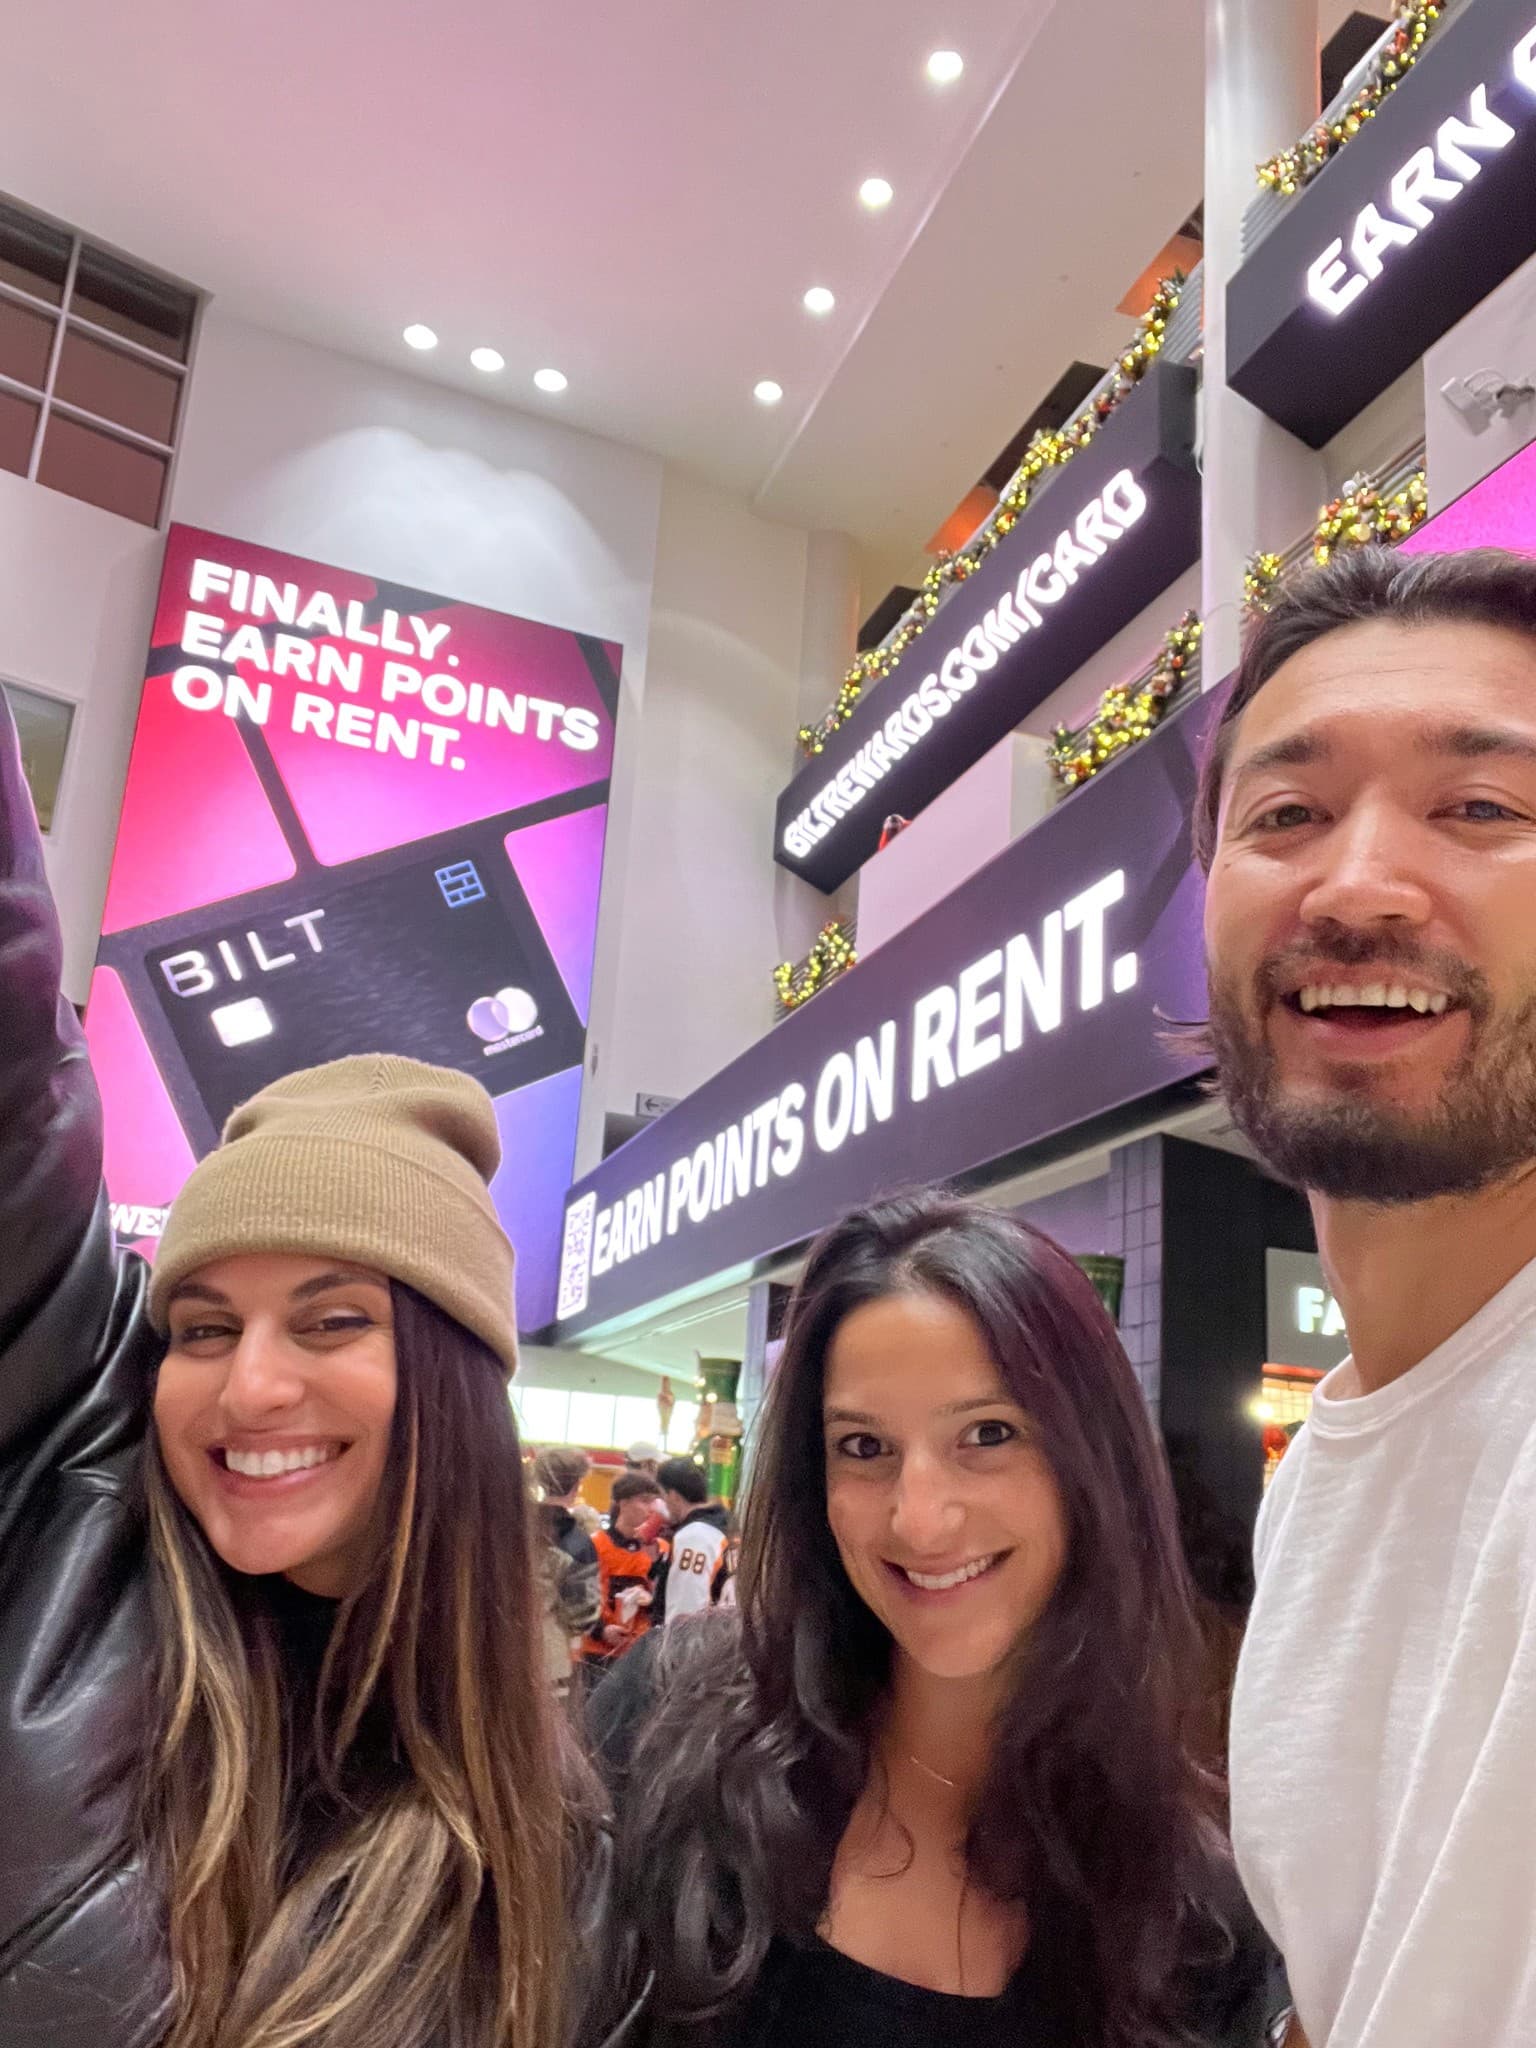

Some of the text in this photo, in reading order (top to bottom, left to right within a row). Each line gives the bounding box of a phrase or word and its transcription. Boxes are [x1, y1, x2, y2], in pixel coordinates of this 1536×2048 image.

[1307, 82, 1516, 316] EARN
[188, 558, 460, 667] FINALLY.
[783, 468, 1147, 859] BILTREWARDS.COM/CARD
[171, 665, 466, 771] ON RENT.
[181, 610, 599, 751] EARN POINTS
[160, 908, 325, 998] BILT
[591, 869, 1138, 1277] EARN POINTS ON RENT.
[679, 1548, 706, 1575] 88
